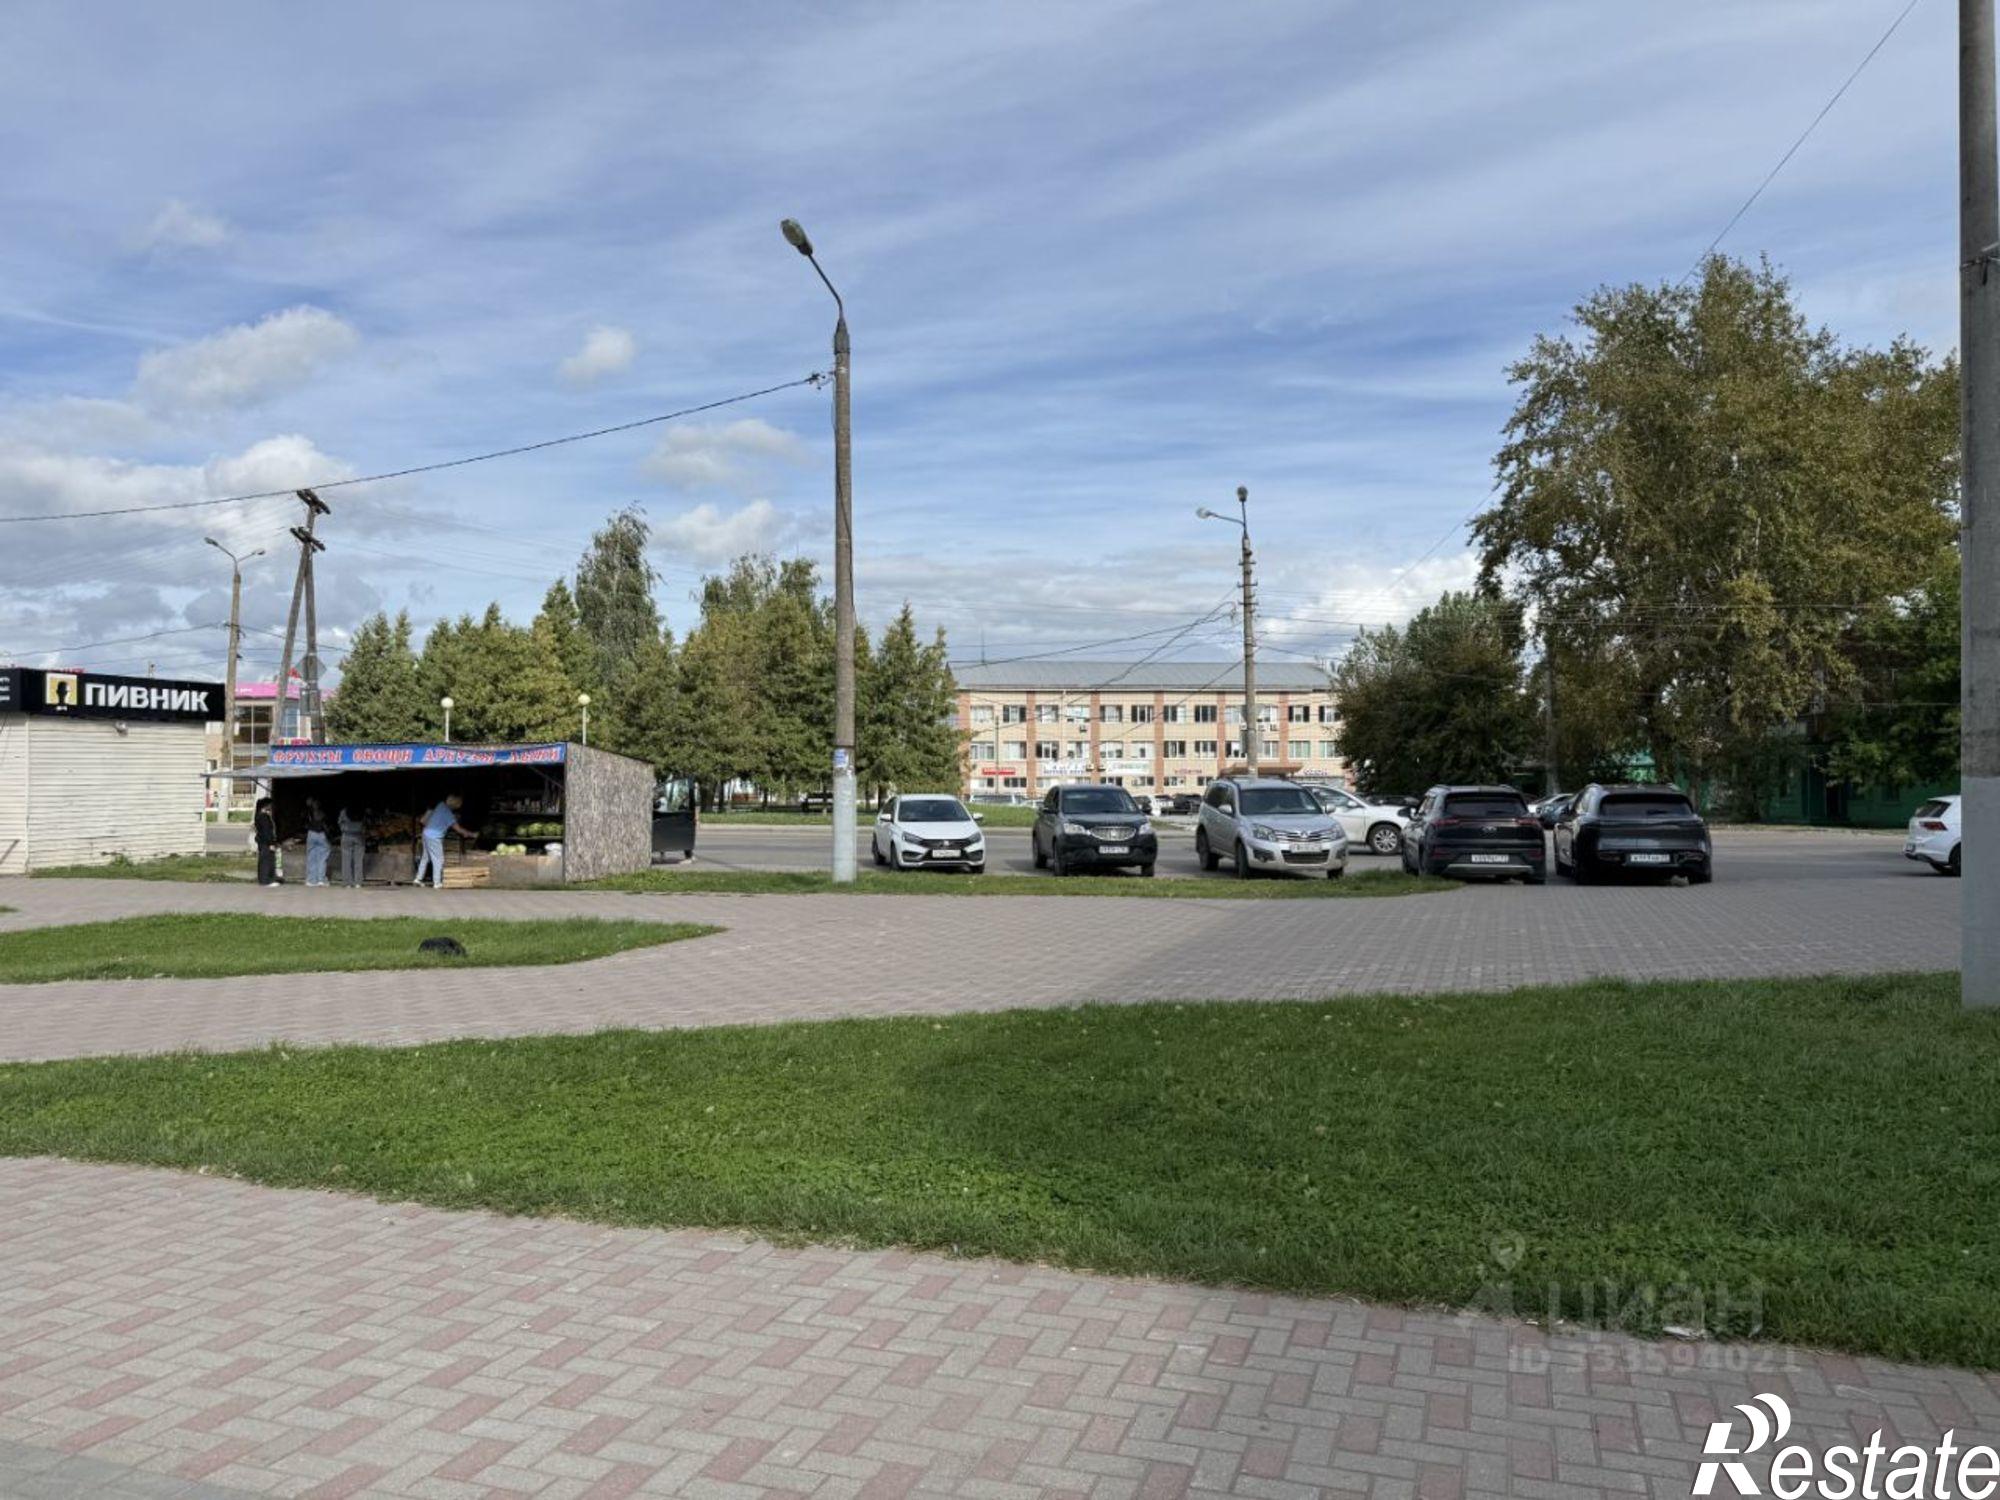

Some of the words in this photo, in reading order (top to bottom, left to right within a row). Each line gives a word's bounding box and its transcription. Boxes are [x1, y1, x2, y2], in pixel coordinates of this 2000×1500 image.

[85, 682, 209, 713] ПИВНИК
[273, 750, 343, 763] ФРУКТЫ
[353, 748, 413, 764] ОВОЩИ
